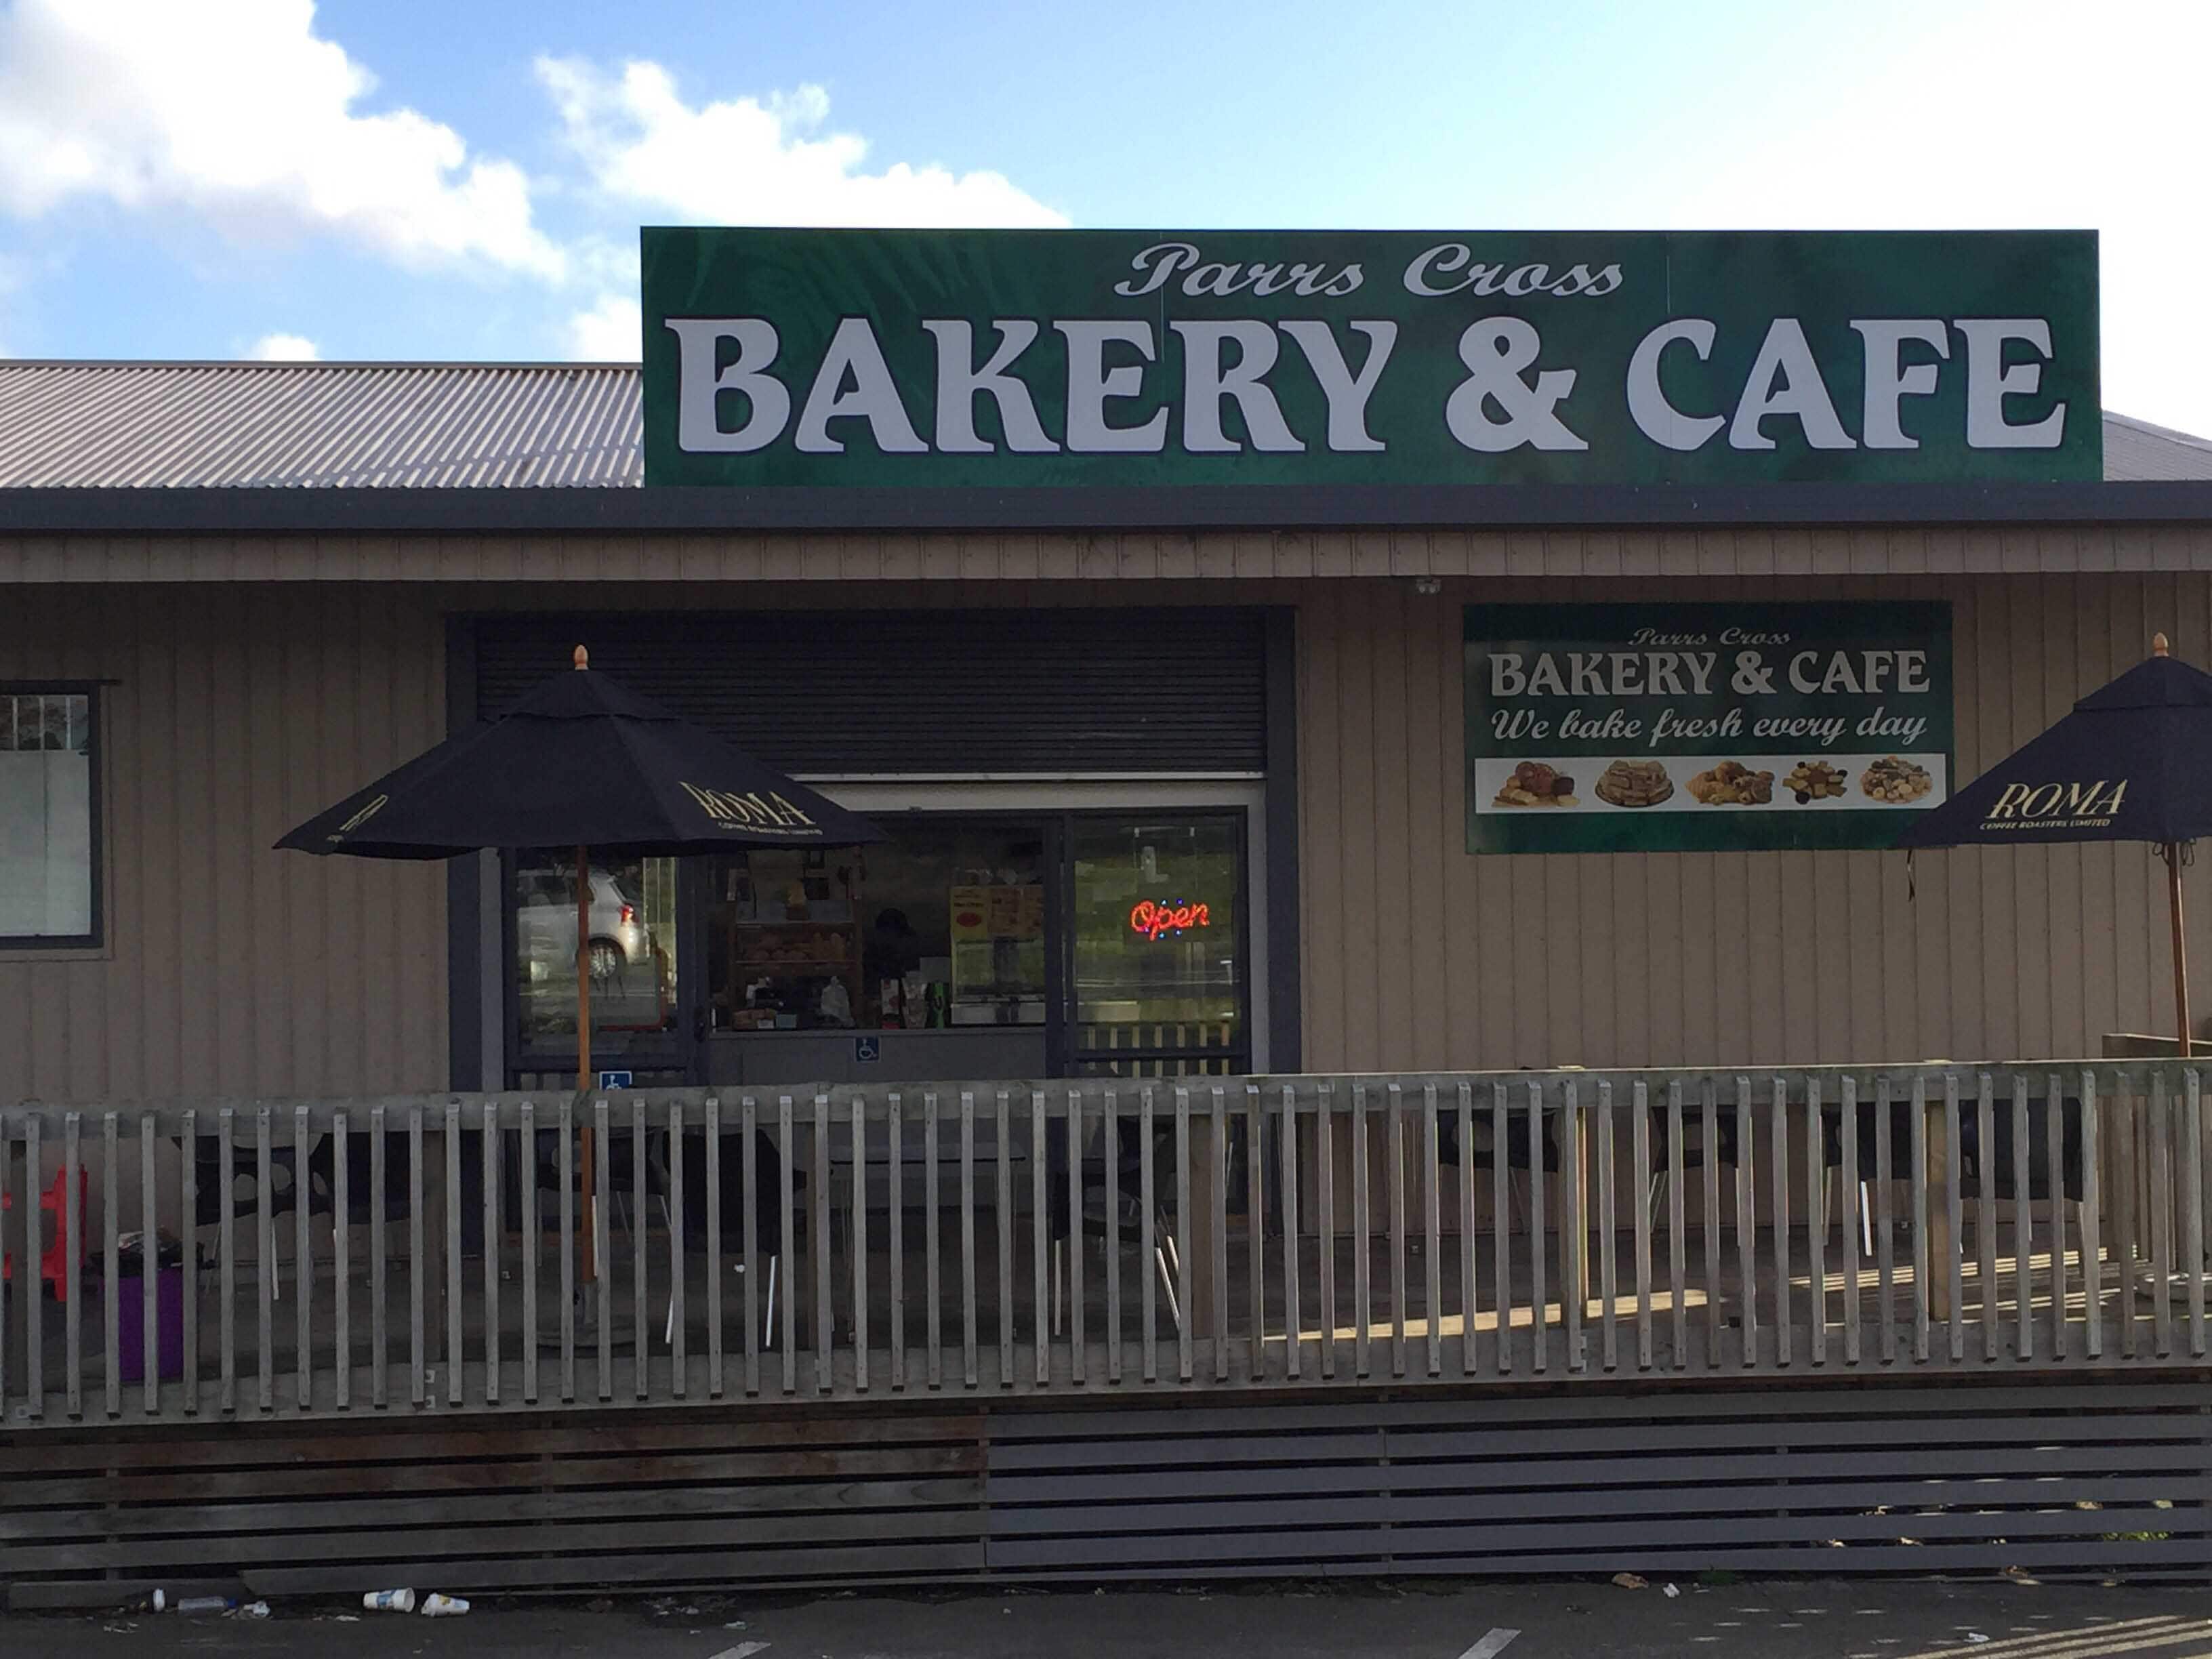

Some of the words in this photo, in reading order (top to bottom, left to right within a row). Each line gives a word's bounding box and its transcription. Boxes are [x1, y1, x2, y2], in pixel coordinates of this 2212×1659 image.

[1113, 242, 1364, 297] Parrs
[1403, 243, 1623, 298] Cross
[664, 317, 1398, 454] BAKERY
[1446, 316, 1589, 453] &
[1626, 317, 2066, 450] CAFE
[1628, 628, 1708, 646] Parrs
[1719, 628, 1791, 645] Cross
[1488, 652, 1717, 696] BAKERY
[1730, 651, 1777, 694] &
[1788, 651, 1930, 693] CAFE
[1491, 709, 1549, 740] We
[1559, 709, 1642, 740] bake
[1649, 708, 1743, 747] fresh
[1753, 716, 1847, 745] every
[1856, 707, 1927, 744] day
[1985, 779, 2128, 819] ROMA
[2069, 818, 2111, 827] LIMITED
[1131, 900, 1210, 941] Open
